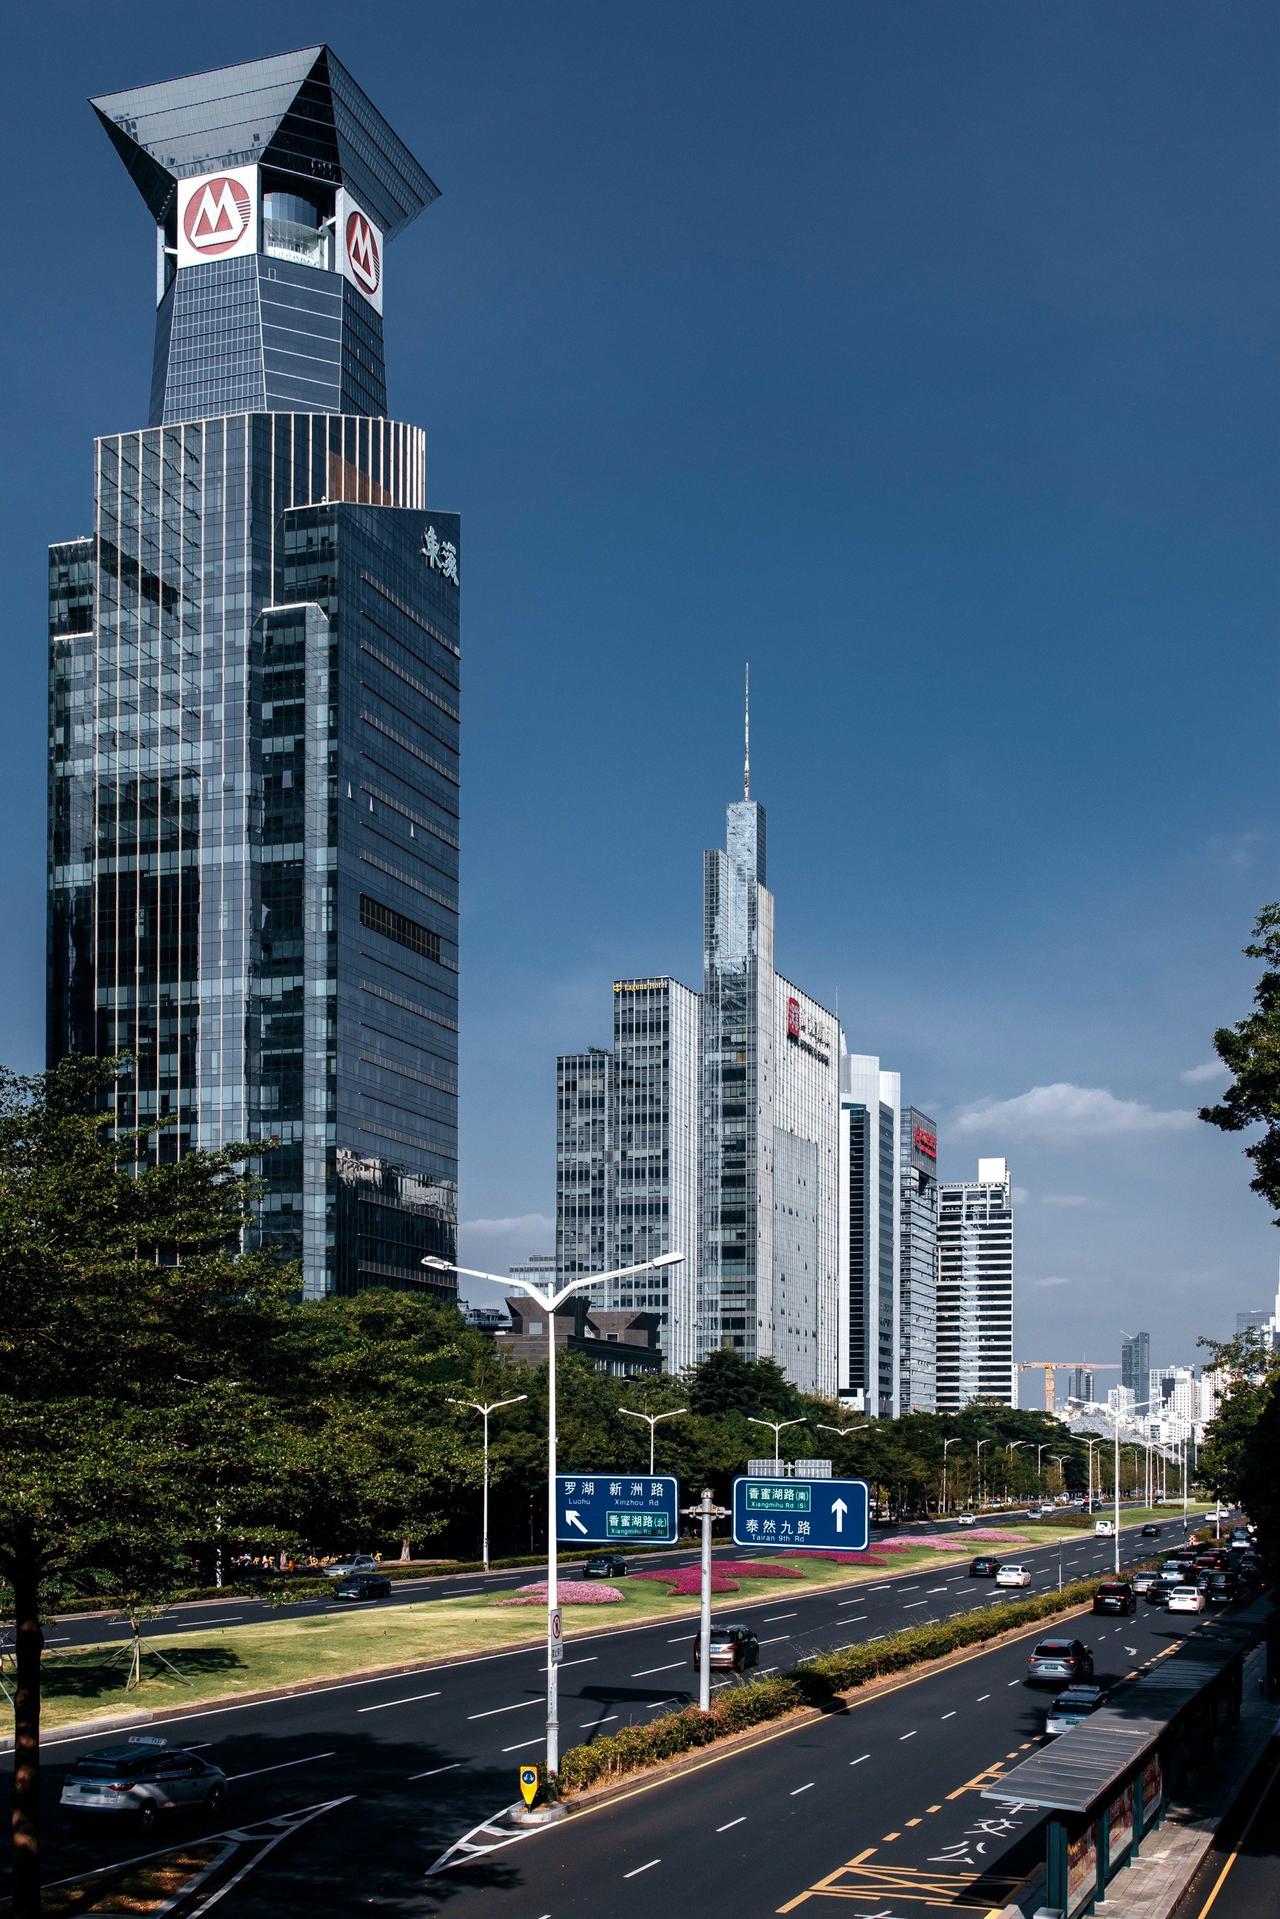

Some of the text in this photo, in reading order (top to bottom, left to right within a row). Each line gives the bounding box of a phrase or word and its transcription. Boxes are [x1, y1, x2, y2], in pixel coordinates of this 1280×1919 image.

[564, 1481, 595, 1496] 罗湖
[609, 1482, 664, 1497] 新洲路
[614, 1498, 643, 1506] Xinzhou
[751, 1501, 783, 1509] Xiangmihu
[745, 1518, 811, 1535] 泰然九路
